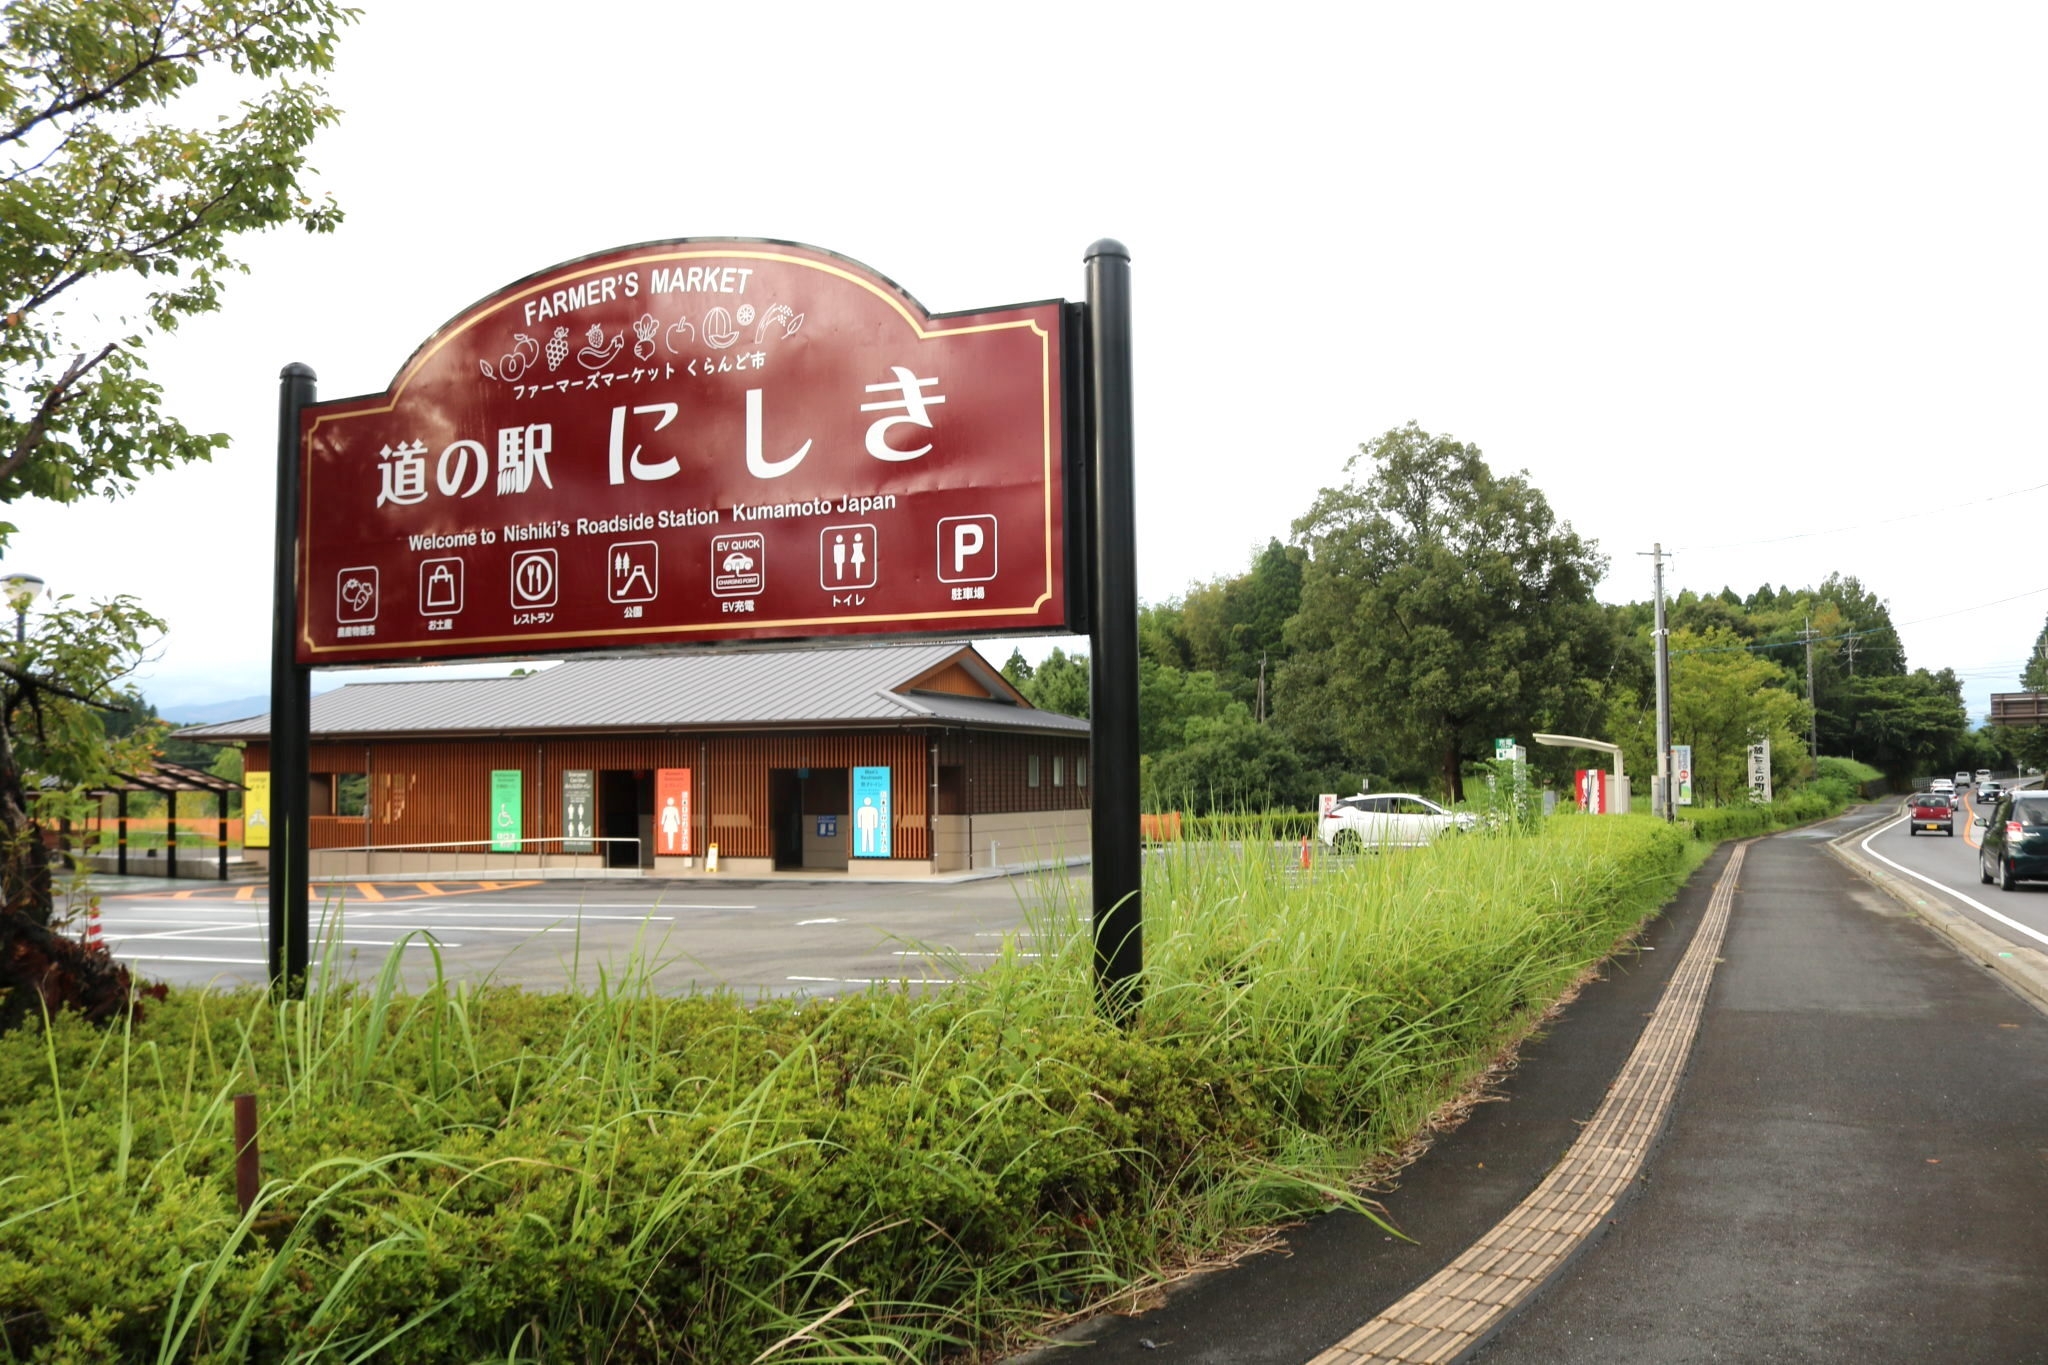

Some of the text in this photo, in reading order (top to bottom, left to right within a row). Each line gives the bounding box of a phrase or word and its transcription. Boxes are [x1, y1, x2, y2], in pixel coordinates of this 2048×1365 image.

[524, 267, 753, 326] FARMER'S MARKET
[513, 351, 767, 400] ファーマーズマーケット くらんど市
[377, 366, 946, 508] 道の駅 にしき
[408, 493, 896, 552] Welcome to Nishiki's Roadside Station Kumamoto Japan
[716, 538, 761, 552] EV QUICK
[955, 524, 983, 572] P
[718, 578, 742, 586] CHARGING
[832, 593, 865, 608] トイレ
[951, 586, 985, 601] 駐車場
[623, 605, 643, 619] 公園
[721, 599, 755, 613] EV充電
[427, 618, 453, 631] お土産
[513, 612, 554, 626] レストラン
